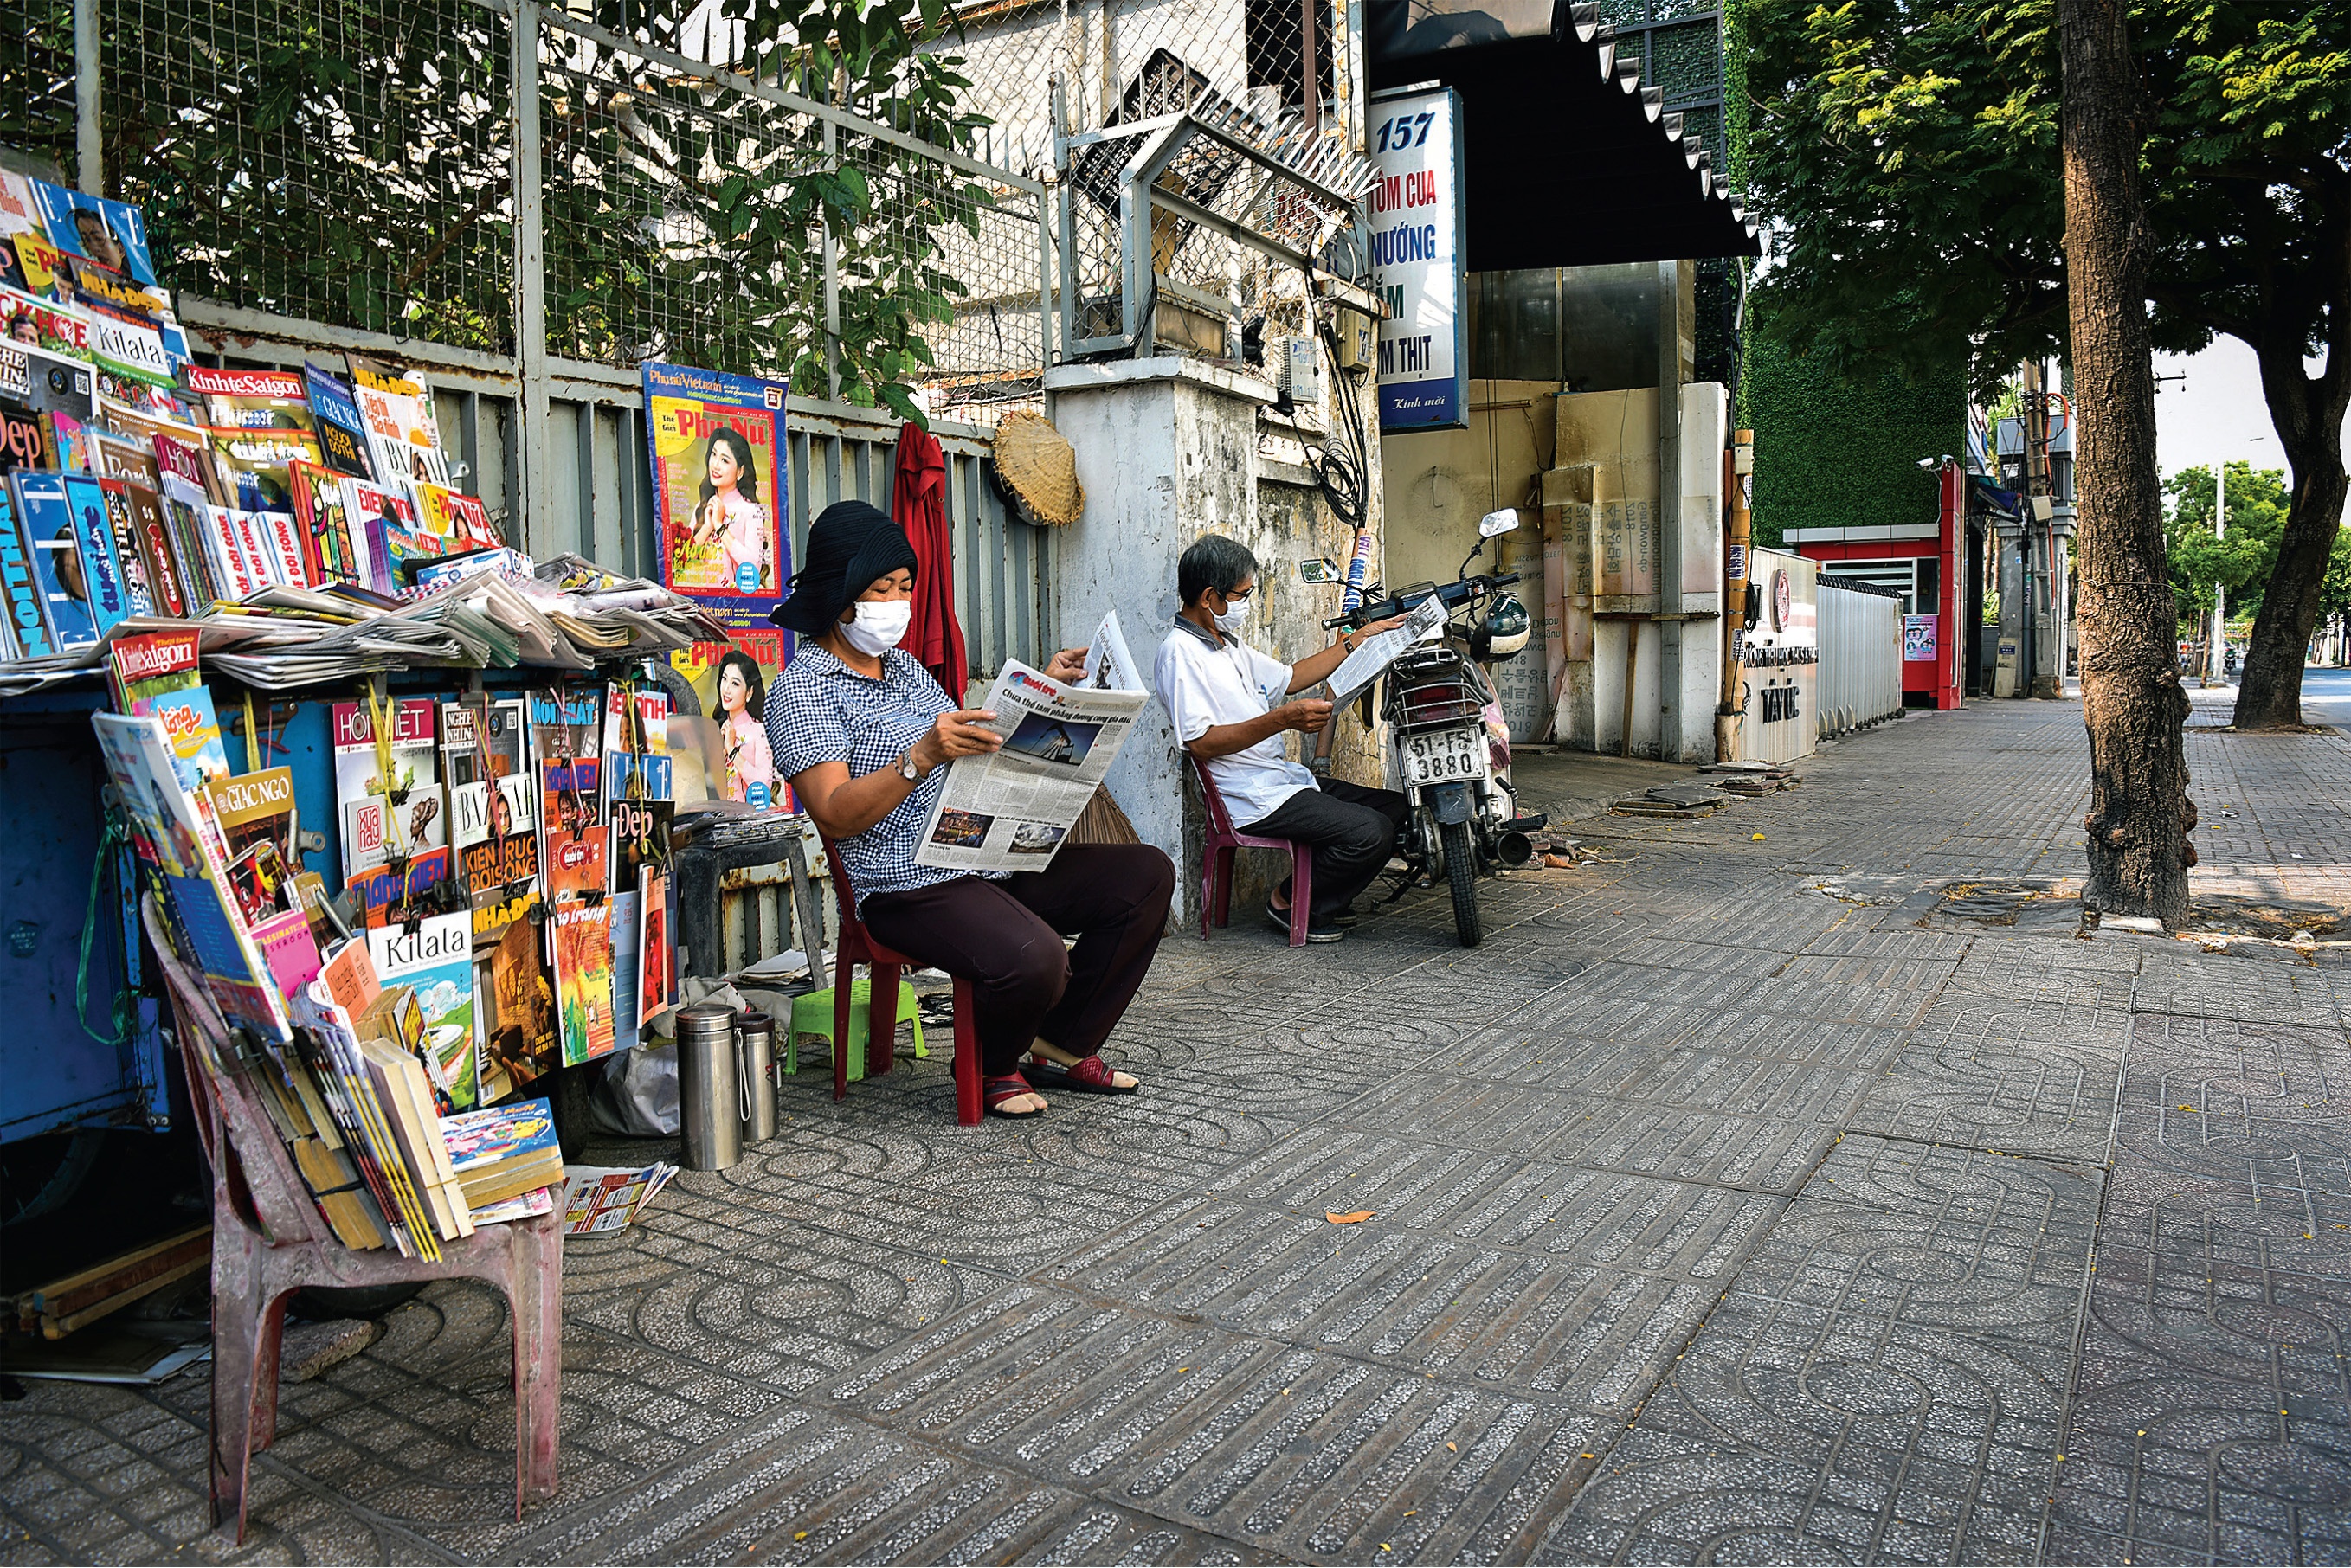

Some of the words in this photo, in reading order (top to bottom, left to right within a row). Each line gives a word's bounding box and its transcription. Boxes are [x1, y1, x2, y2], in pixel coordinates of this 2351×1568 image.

[1376, 112, 1435, 154] 157
[1406, 170, 1437, 209] CUA
[1372, 221, 1436, 267] NƯỚNG
[97, 323, 162, 365] Kilala
[1399, 335, 1431, 379] THỊT
[1417, 753, 1472, 780] 3880
[386, 926, 466, 968] Kilala
